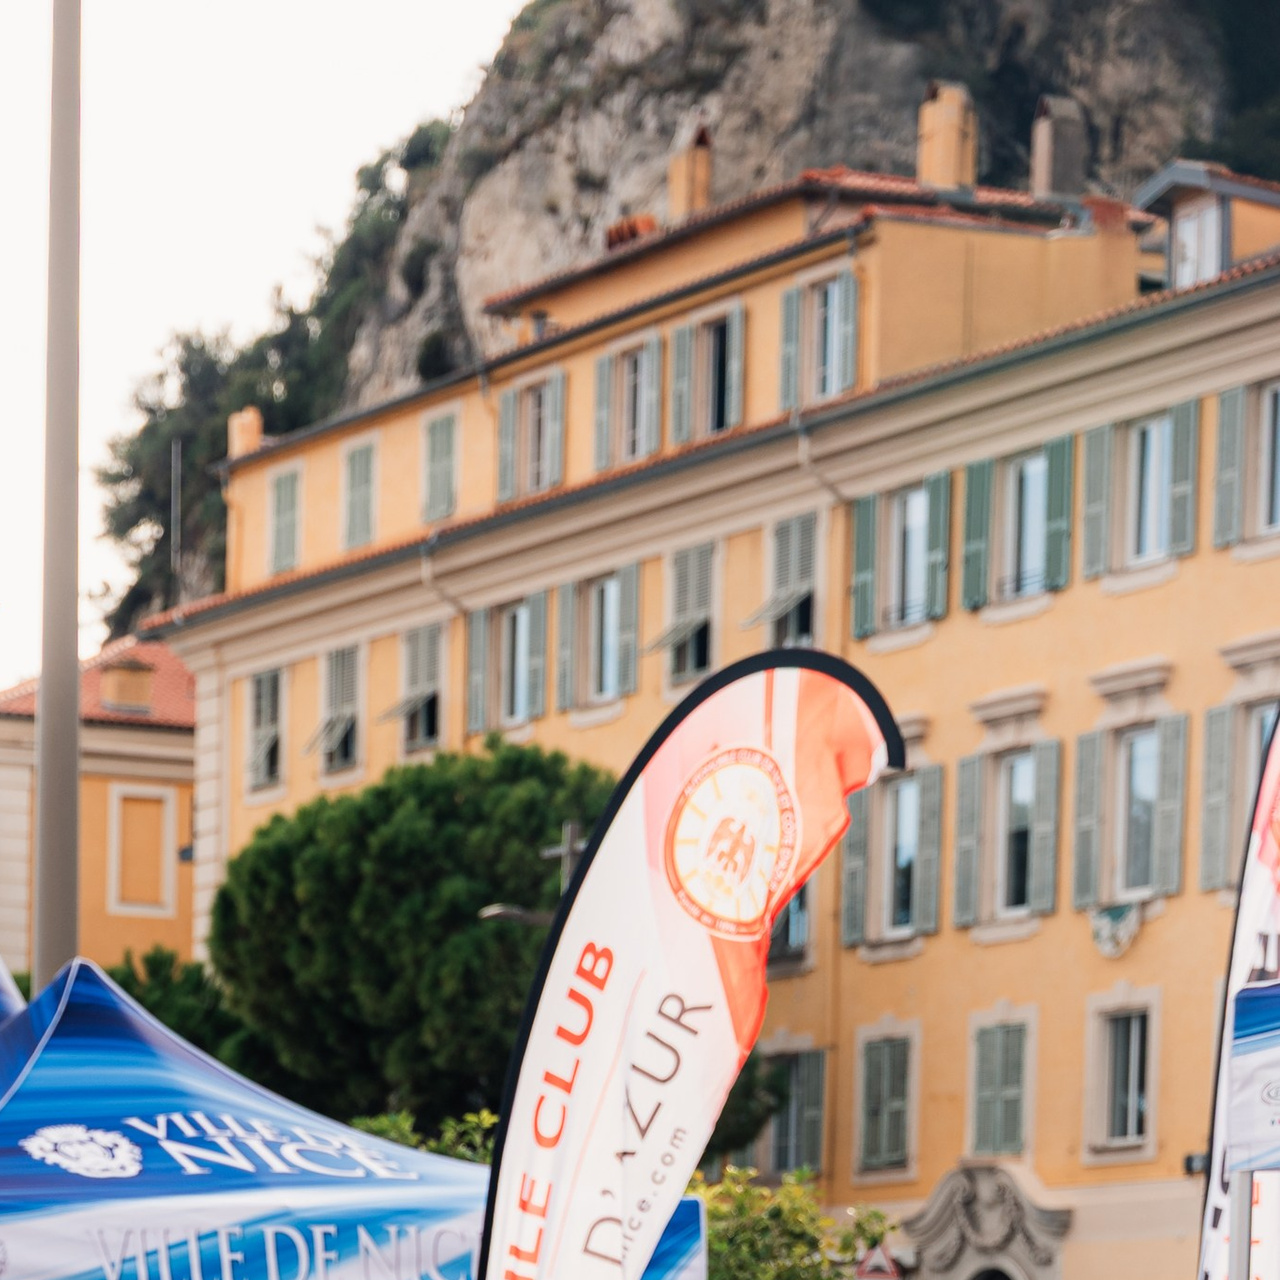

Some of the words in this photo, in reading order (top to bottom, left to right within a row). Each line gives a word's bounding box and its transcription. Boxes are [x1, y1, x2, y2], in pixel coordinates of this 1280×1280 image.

[533, 941, 614, 1149] CLUB
[123, 1111, 288, 1142] VILLE
[159, 1137, 419, 1181] NICE
